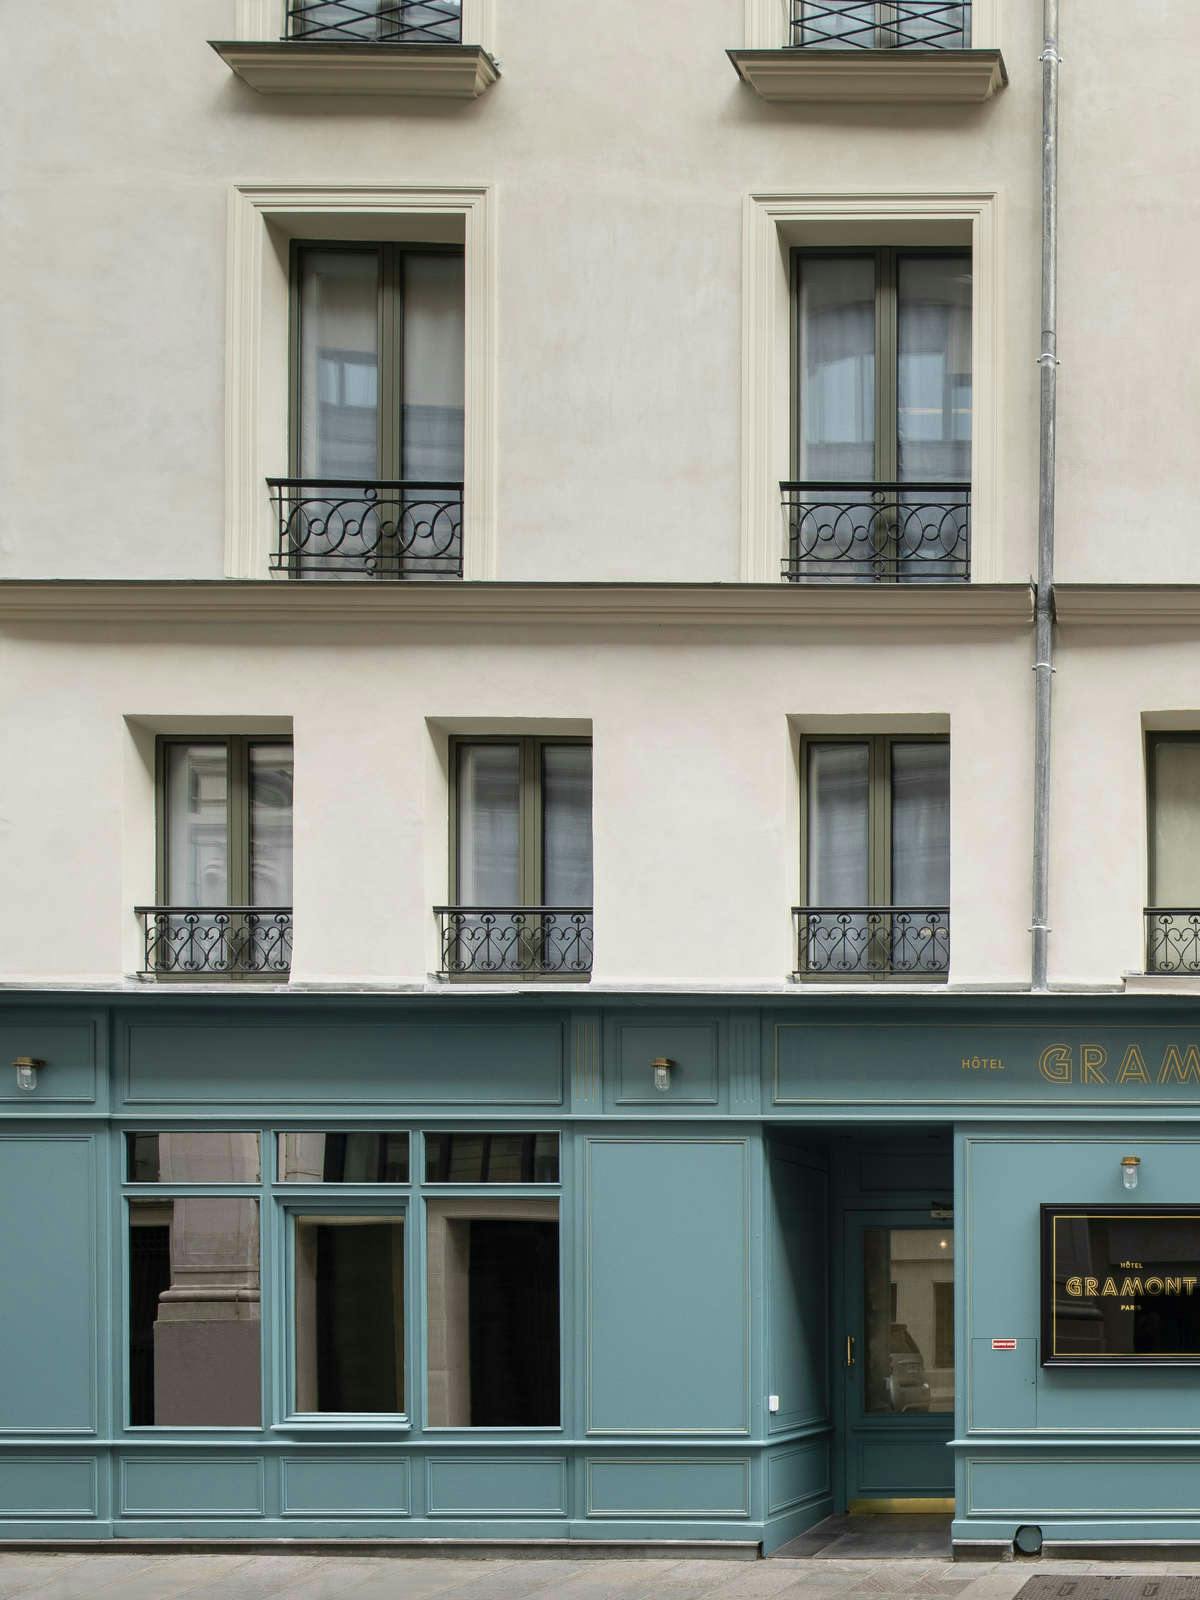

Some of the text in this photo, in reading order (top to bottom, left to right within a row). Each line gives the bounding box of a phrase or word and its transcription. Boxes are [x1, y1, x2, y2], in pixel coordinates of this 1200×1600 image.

[961, 1055, 1005, 1070] HÔTEL
[1120, 1260, 1144, 1269] HÔTEL
[1065, 1275, 1198, 1297] GRAMONT
